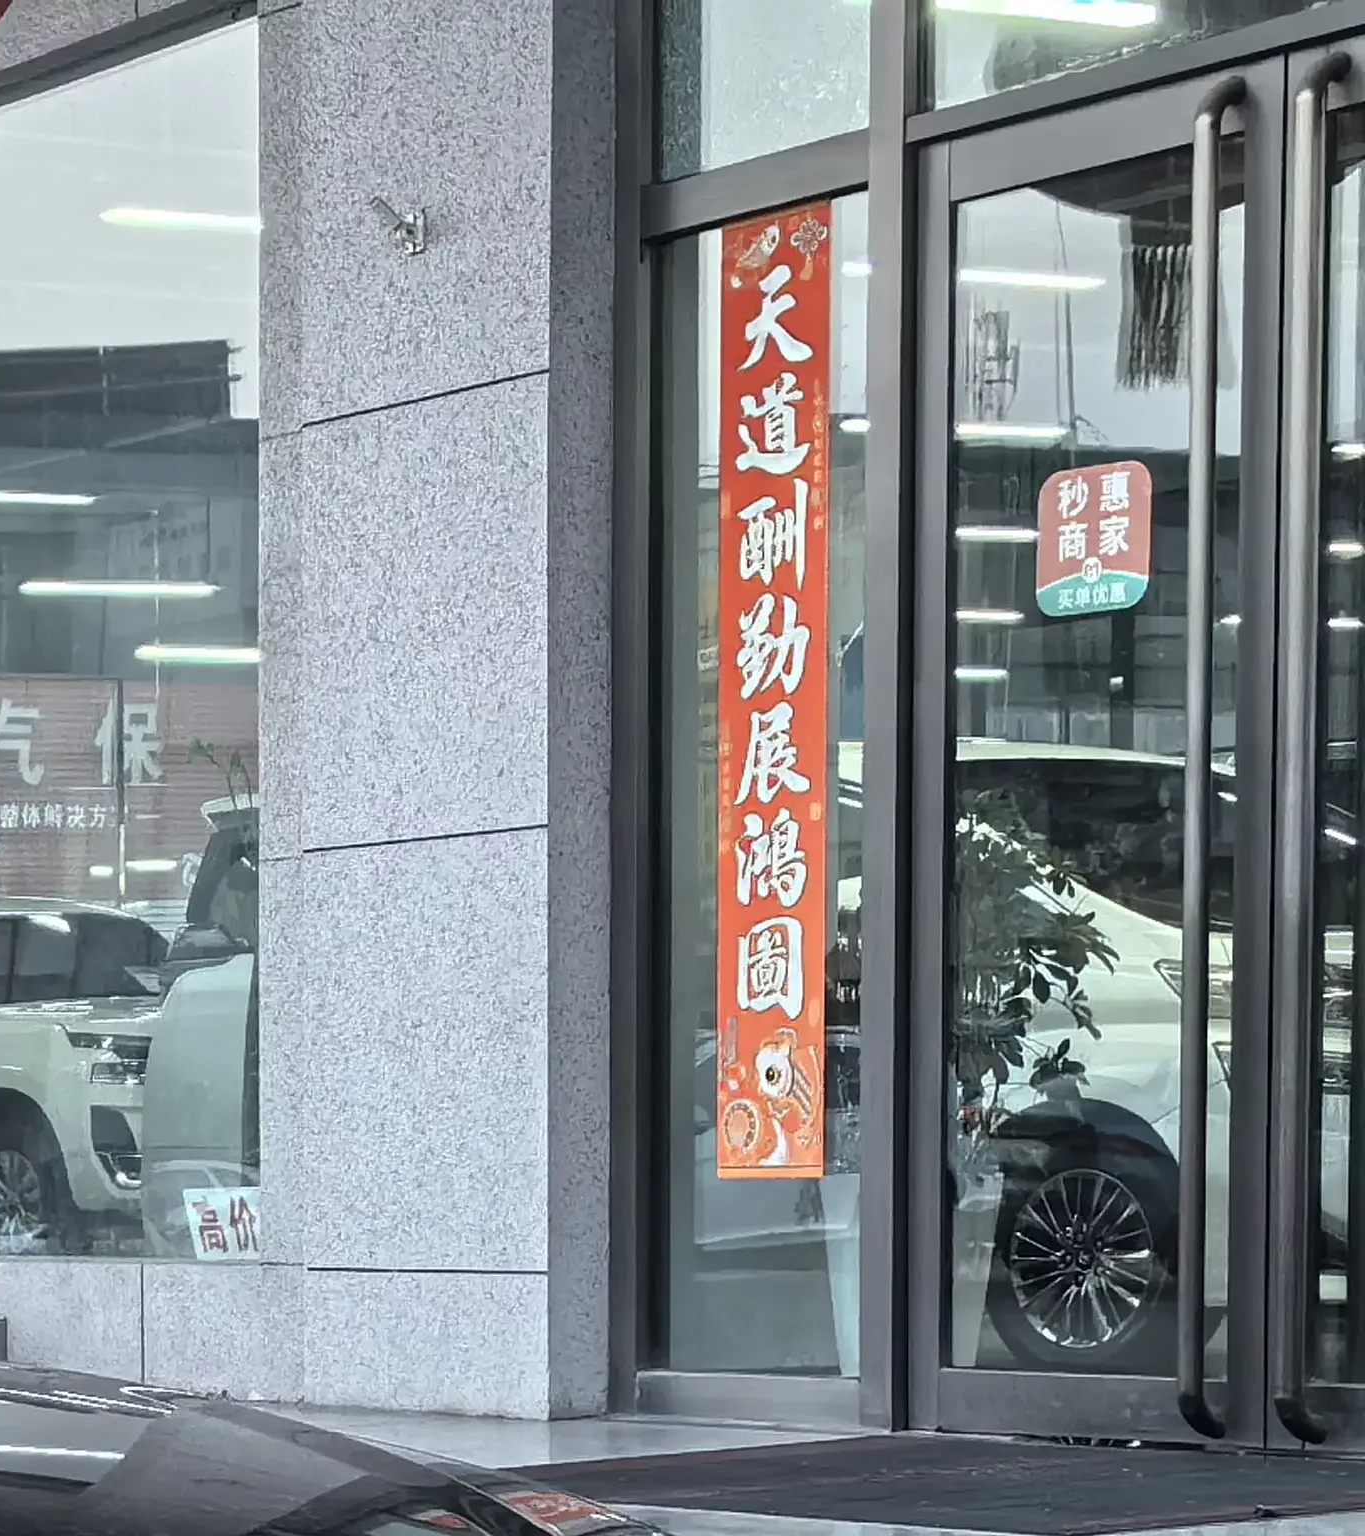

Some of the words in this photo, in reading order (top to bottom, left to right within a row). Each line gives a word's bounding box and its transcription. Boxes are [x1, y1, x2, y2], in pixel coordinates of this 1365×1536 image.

[1058, 516, 1129, 563] 商家
[1058, 582, 1127, 609] 买单优惠
